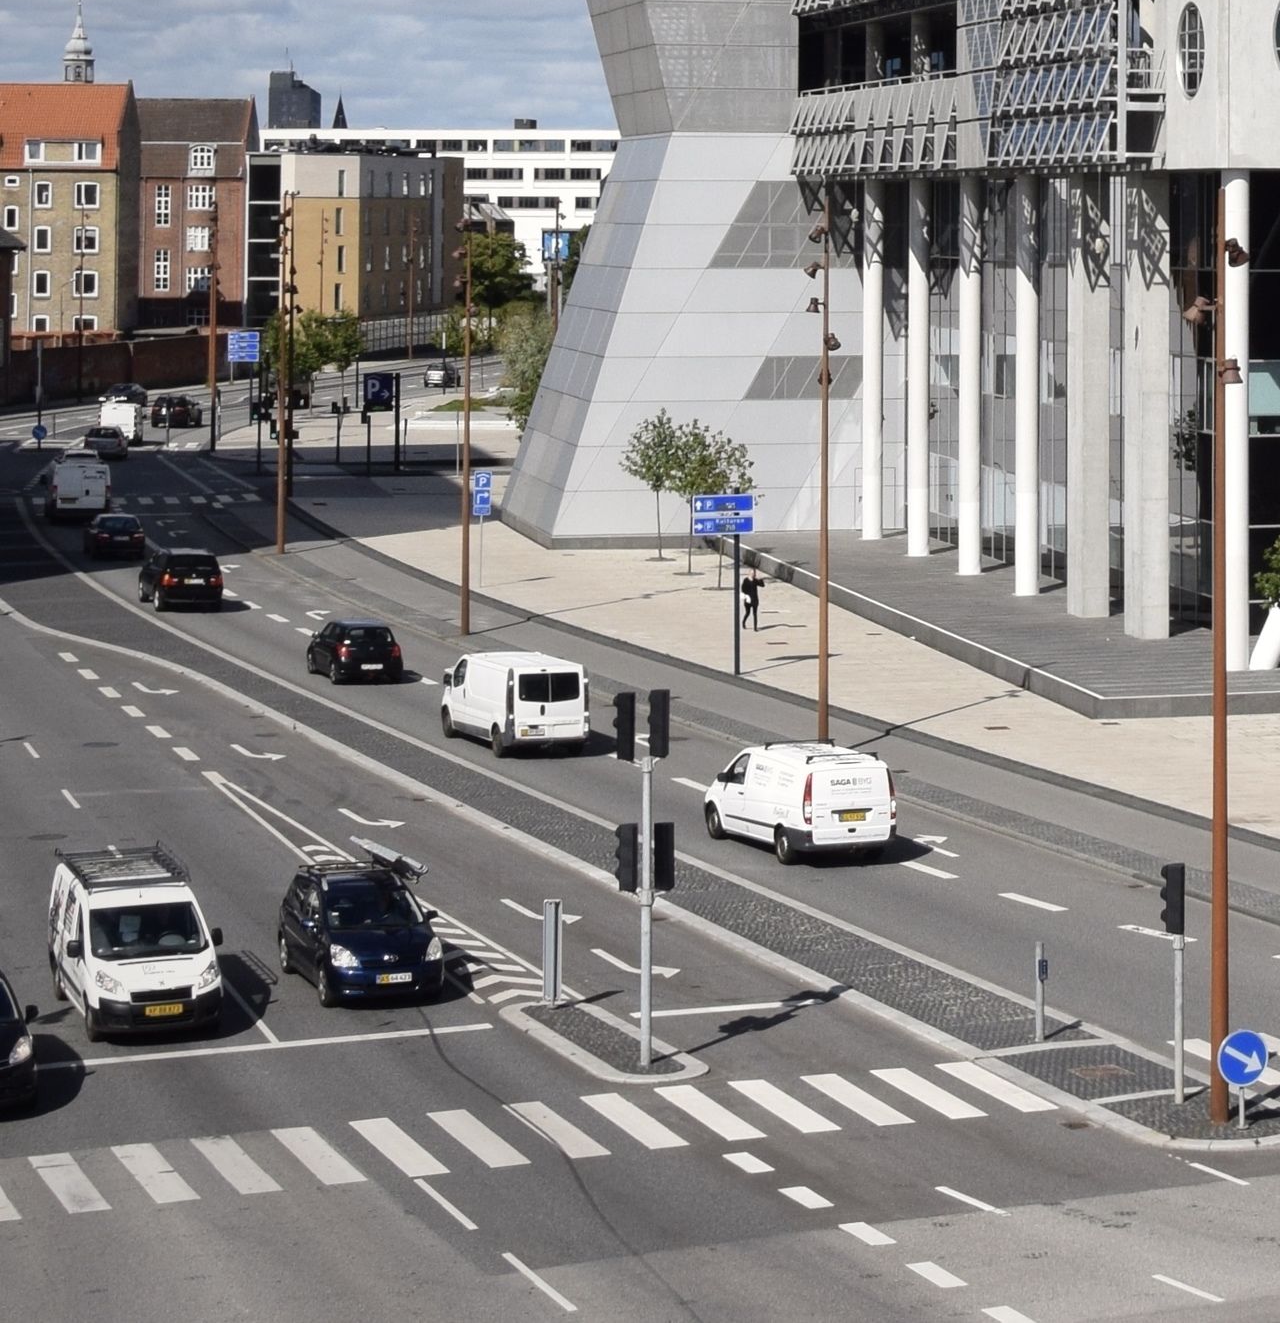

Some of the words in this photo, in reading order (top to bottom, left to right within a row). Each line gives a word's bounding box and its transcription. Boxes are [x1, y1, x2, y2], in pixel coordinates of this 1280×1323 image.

[367, 379, 380, 399] P
[479, 477, 487, 487] P
[830, 778, 851, 787] SAGA
